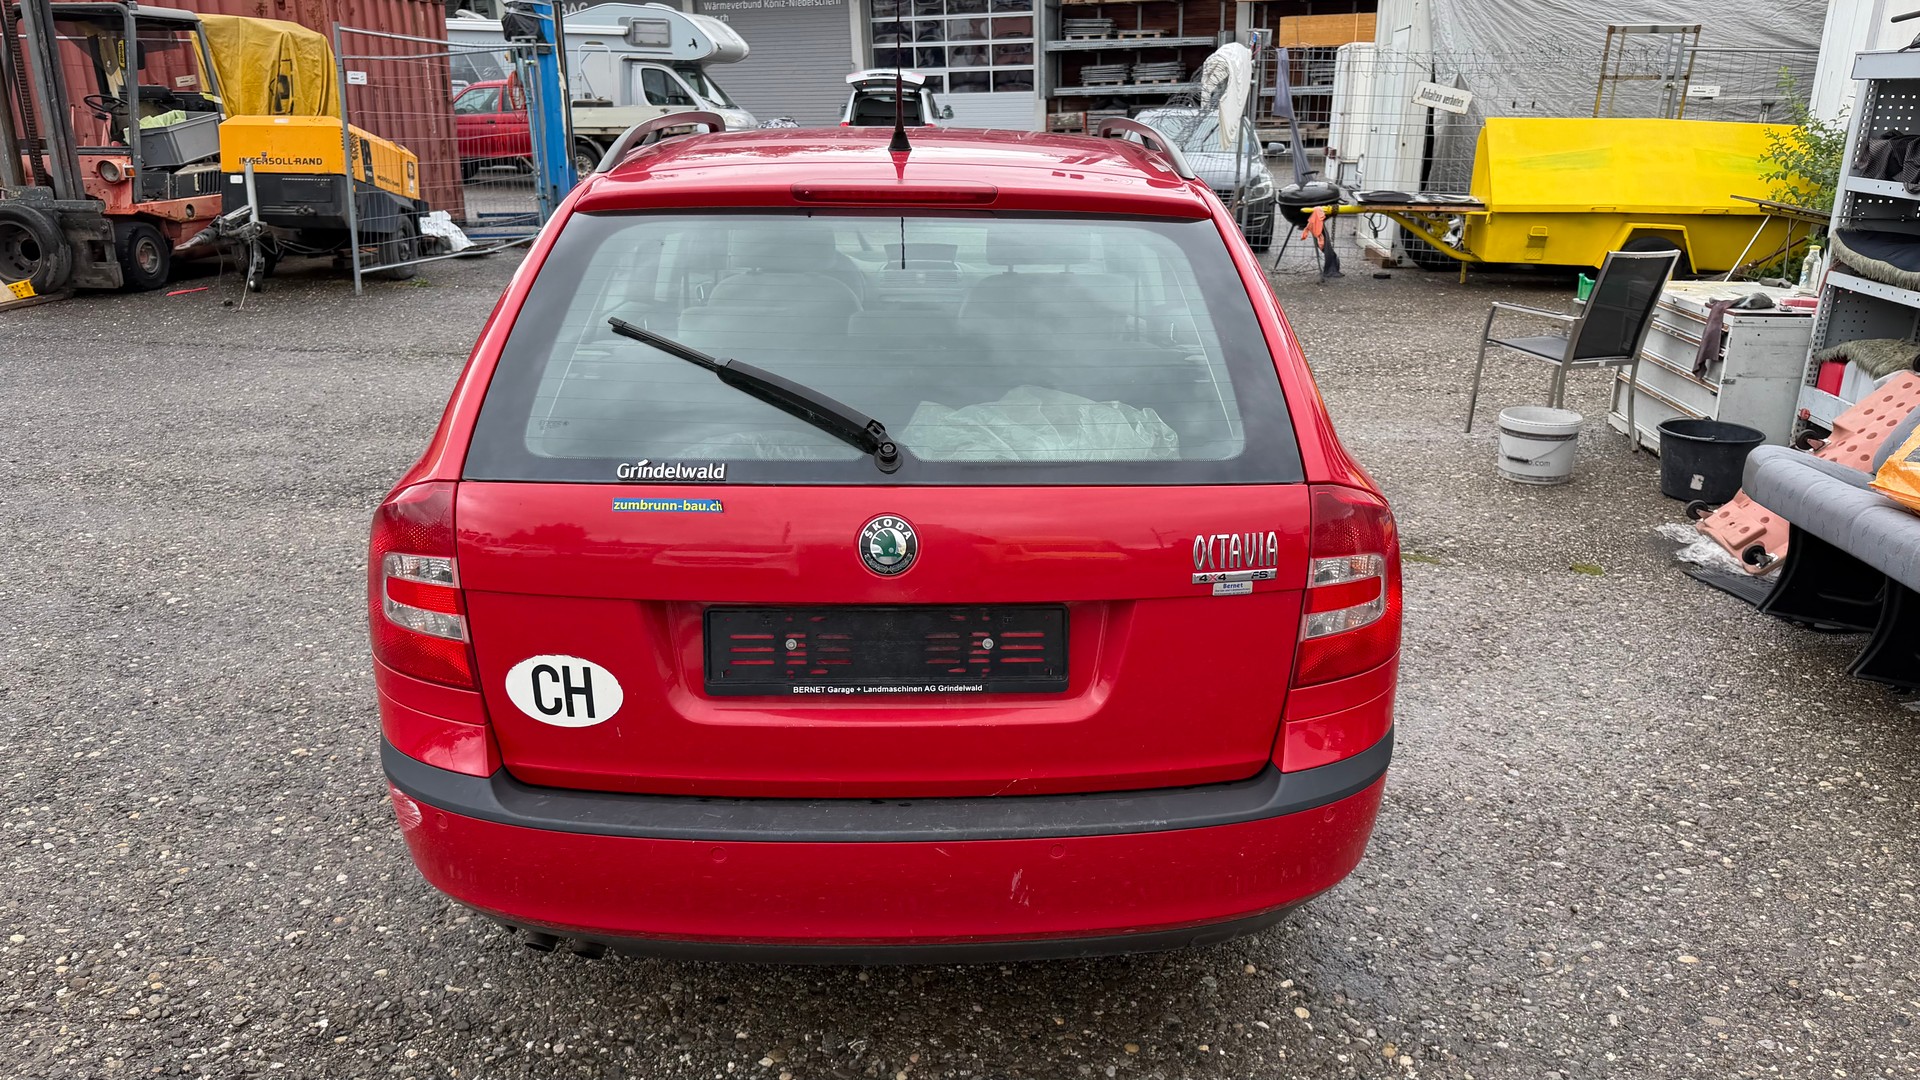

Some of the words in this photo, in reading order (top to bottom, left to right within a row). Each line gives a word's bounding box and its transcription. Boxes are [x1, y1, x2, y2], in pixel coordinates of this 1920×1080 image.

[704, 0, 762, 10] Wärmeverbund
[616, 459, 726, 479] Grindelwald
[613, 499, 723, 511] zumbrunn-bau.ch
[1193, 531, 1278, 571] OCTAVIA
[531, 664, 596, 719] CH
[827, 686, 855, 694] Garage
[863, 685, 923, 693] Landmaschinen
[938, 684, 983, 692] Grindelwald
